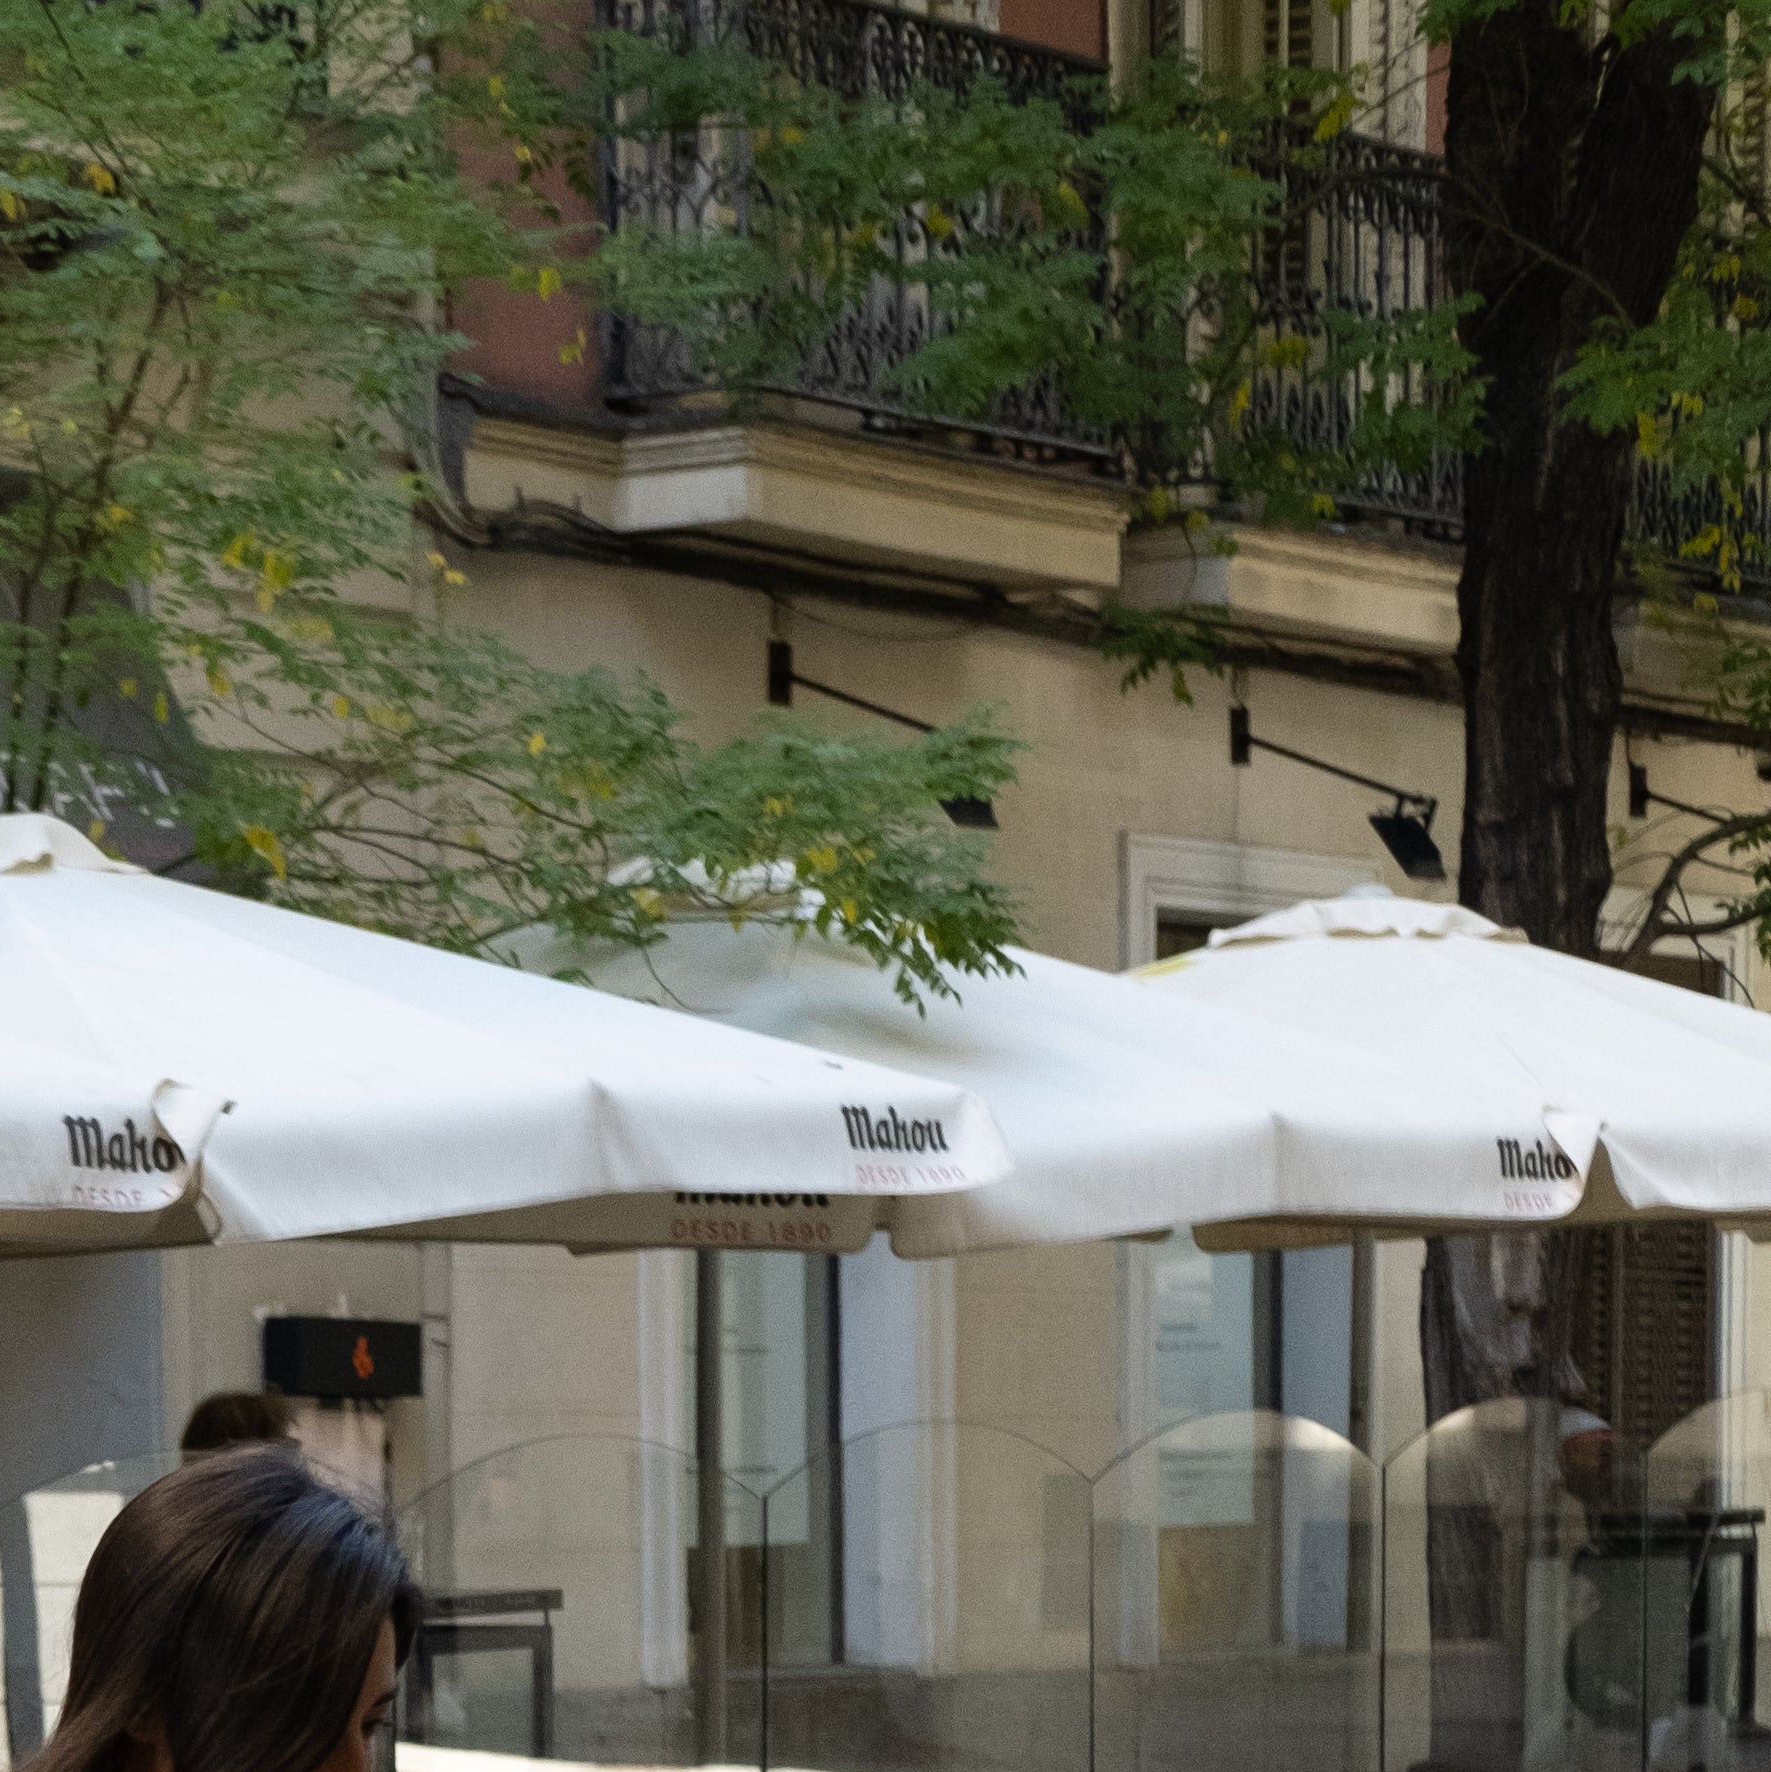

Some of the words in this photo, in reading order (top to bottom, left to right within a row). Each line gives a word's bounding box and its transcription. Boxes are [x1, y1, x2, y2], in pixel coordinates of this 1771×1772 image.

[63, 1114, 188, 1173] Maho
[841, 1105, 949, 1153] Mahou
[856, 1165, 910, 1185] DESDE
[1497, 1138, 1578, 1180] Maho
[672, 1219, 752, 1240] DESDE
[768, 1222, 831, 1243] 1890
